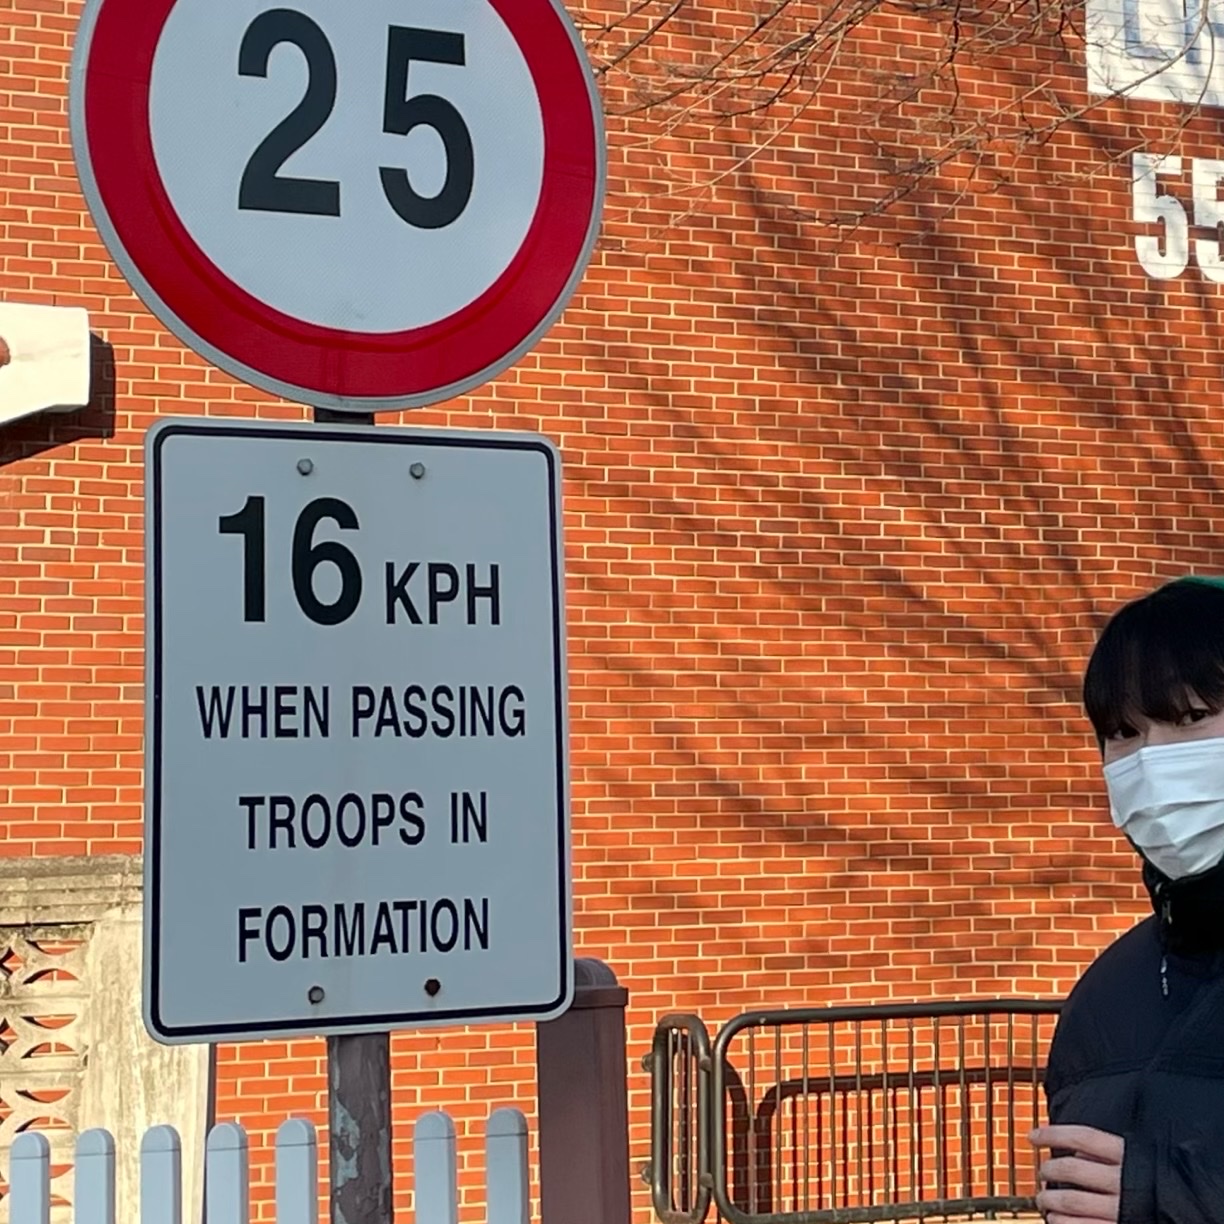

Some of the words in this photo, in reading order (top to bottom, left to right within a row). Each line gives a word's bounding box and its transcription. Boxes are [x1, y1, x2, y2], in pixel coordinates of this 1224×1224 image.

[237, 7, 475, 230] 25
[218, 495, 363, 626] 16
[385, 561, 501, 626] KPH
[195, 685, 330, 740] WHEN
[351, 684, 526, 739] PASSING
[238, 791, 426, 851] TROOPS
[449, 790, 489, 845] IN
[237, 897, 490, 964] FORMATION
